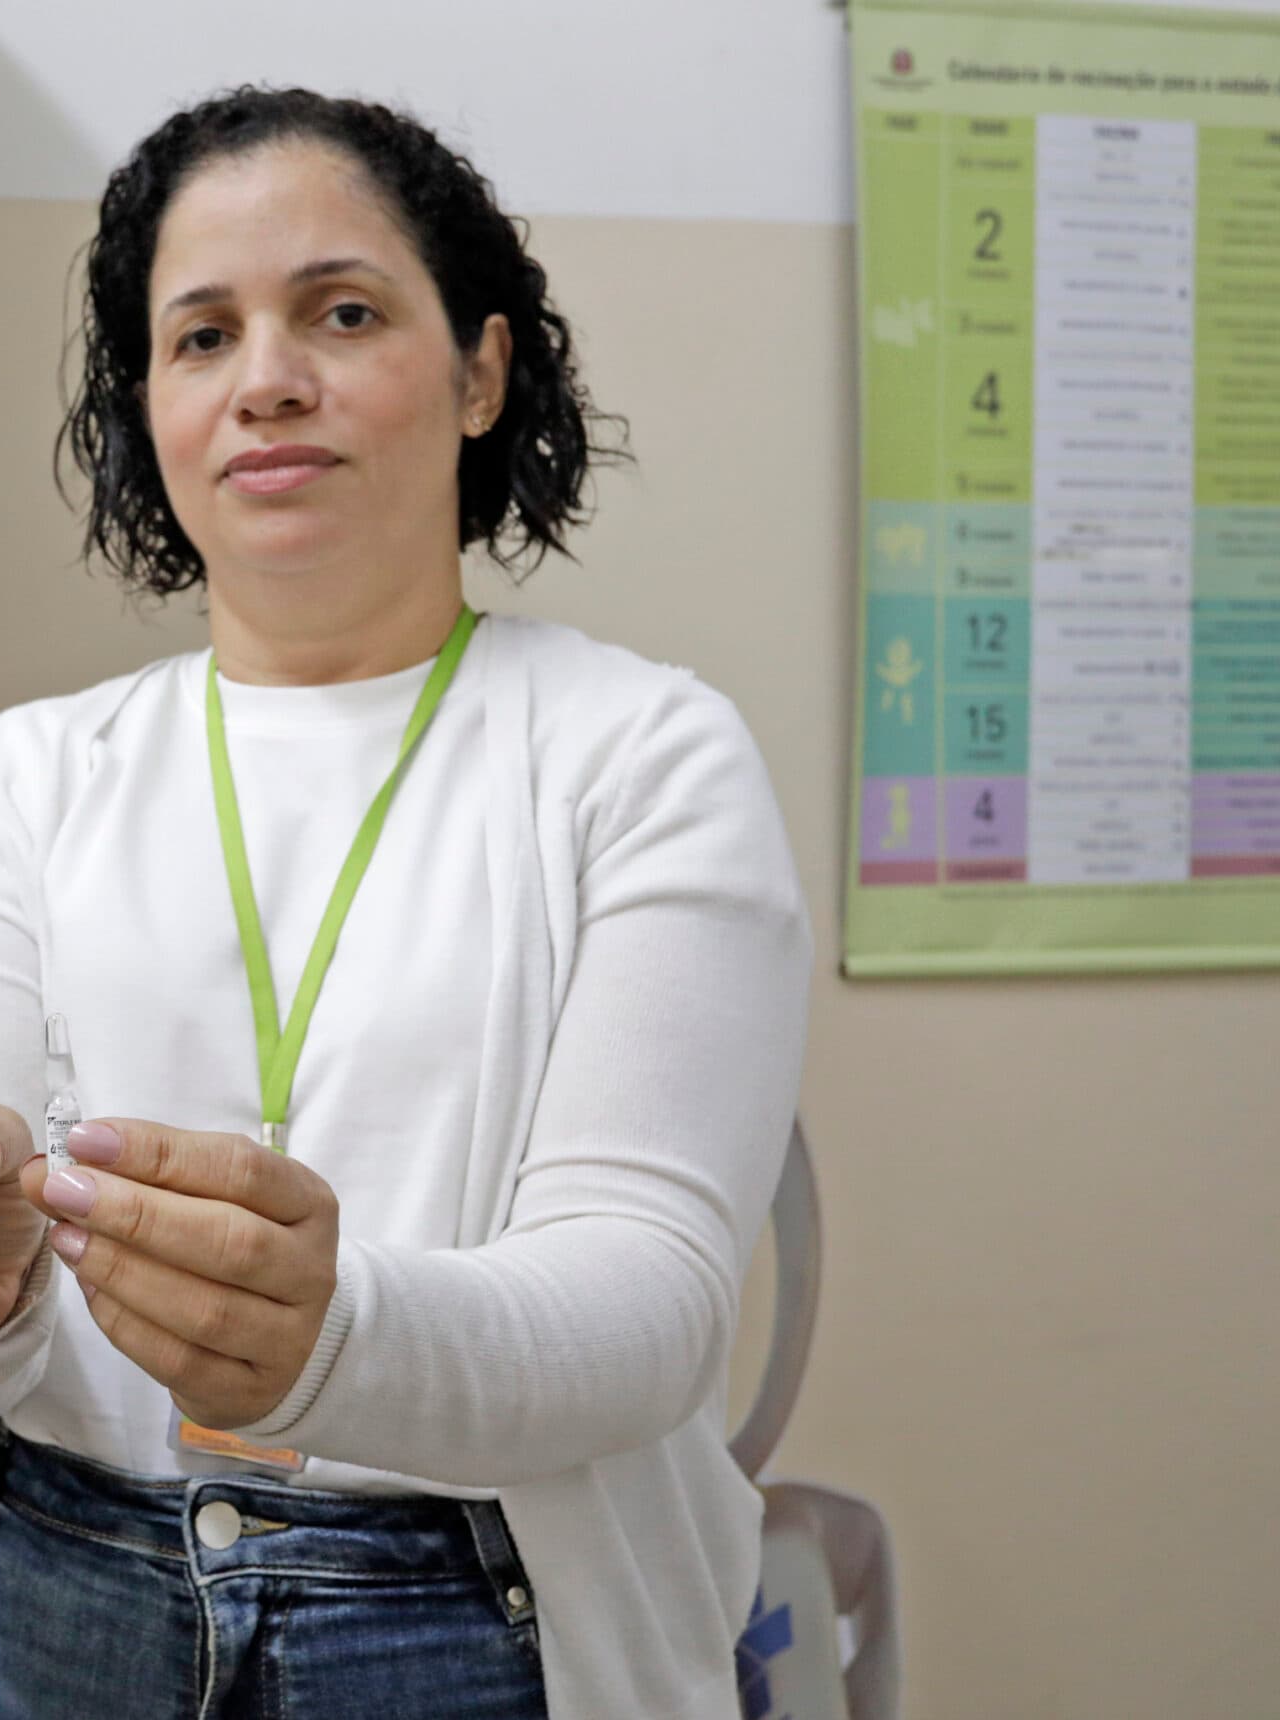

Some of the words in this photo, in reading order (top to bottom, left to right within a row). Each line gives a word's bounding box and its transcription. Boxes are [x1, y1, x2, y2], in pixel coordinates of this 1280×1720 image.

[974, 207, 1003, 262] 2
[971, 371, 1003, 419] 4
[966, 613, 1008, 653] 12
[966, 703, 1006, 744] 15
[973, 789, 995, 823] 4
